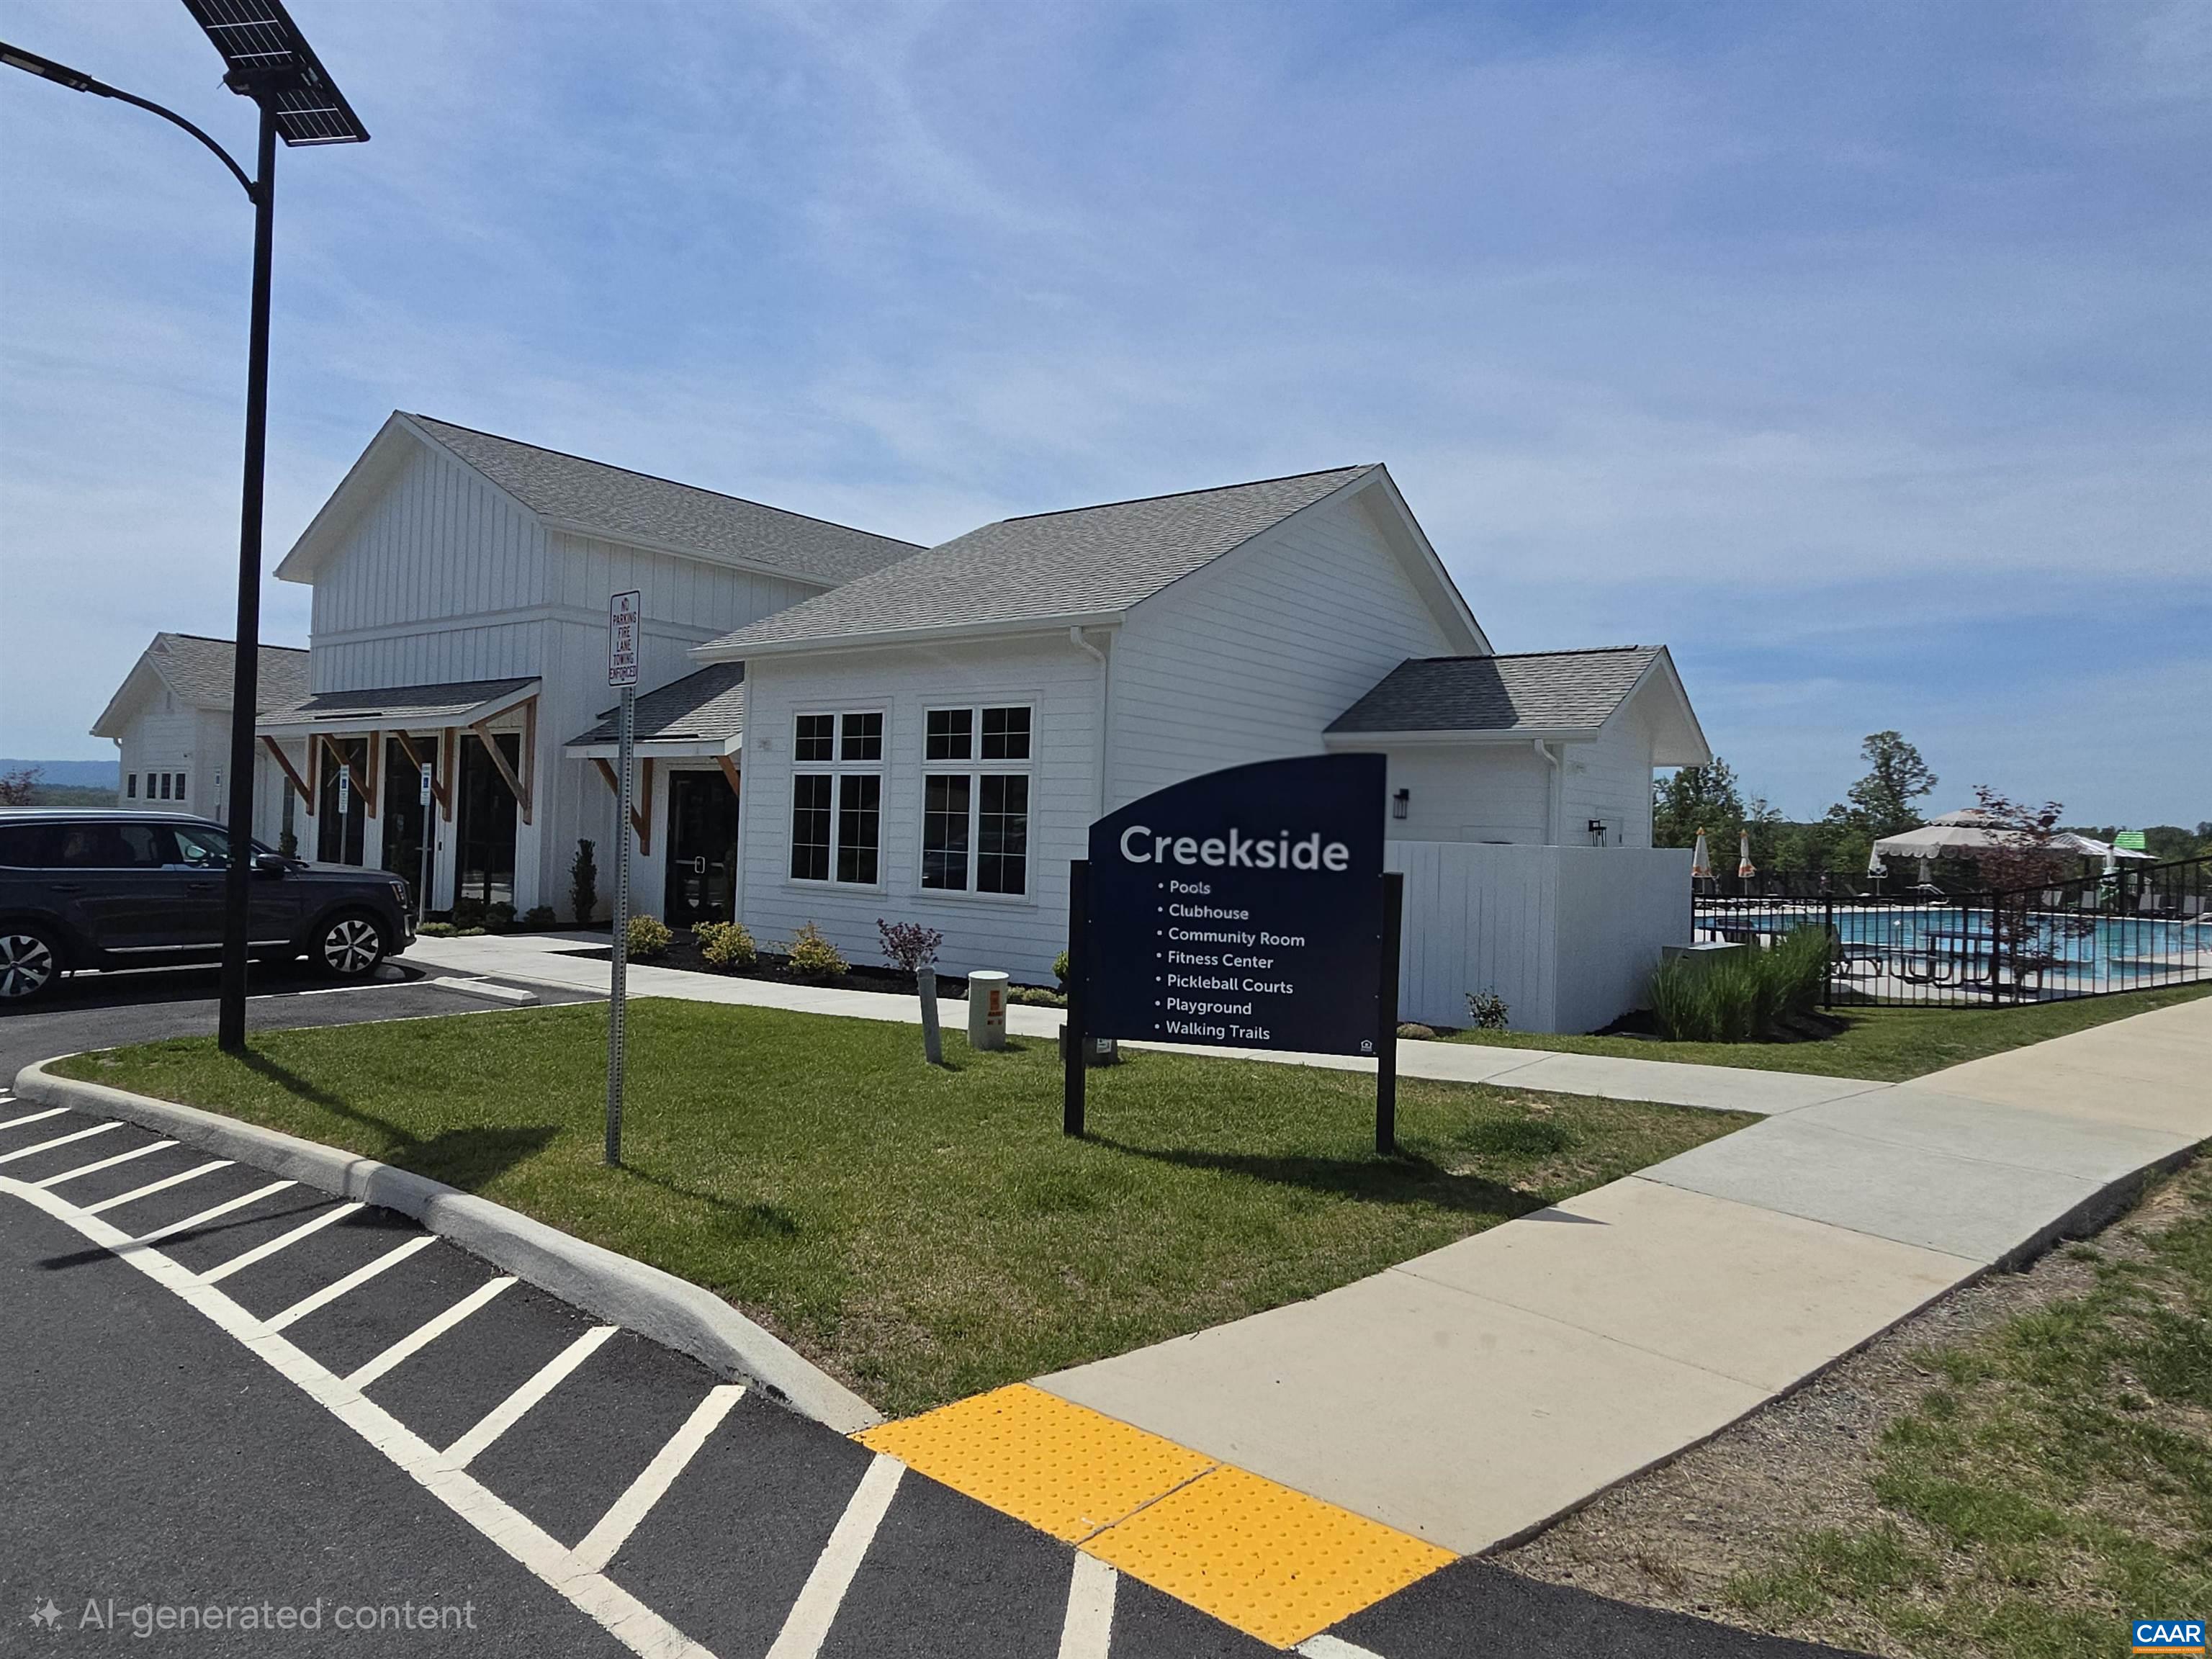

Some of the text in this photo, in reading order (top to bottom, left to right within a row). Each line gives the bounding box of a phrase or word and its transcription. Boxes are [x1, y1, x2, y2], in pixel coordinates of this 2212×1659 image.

[621, 600, 629, 611] NO
[613, 612, 637, 626] PARKING
[619, 626, 631, 638] FIRE
[616, 639, 631, 652] LANE
[613, 652, 634, 666] TOWING
[1120, 825, 1349, 871] Creekside
[1170, 881, 1210, 894] Pools
[1169, 904, 1249, 920] Clubhouse
[1169, 927, 1305, 947] Community Room
[1168, 950, 1274, 969] Fitness Center
[1167, 974, 1293, 994] Pickleball Courts
[1166, 997, 1252, 1015] Playground
[1166, 1020, 1270, 1040] Walking Trails
